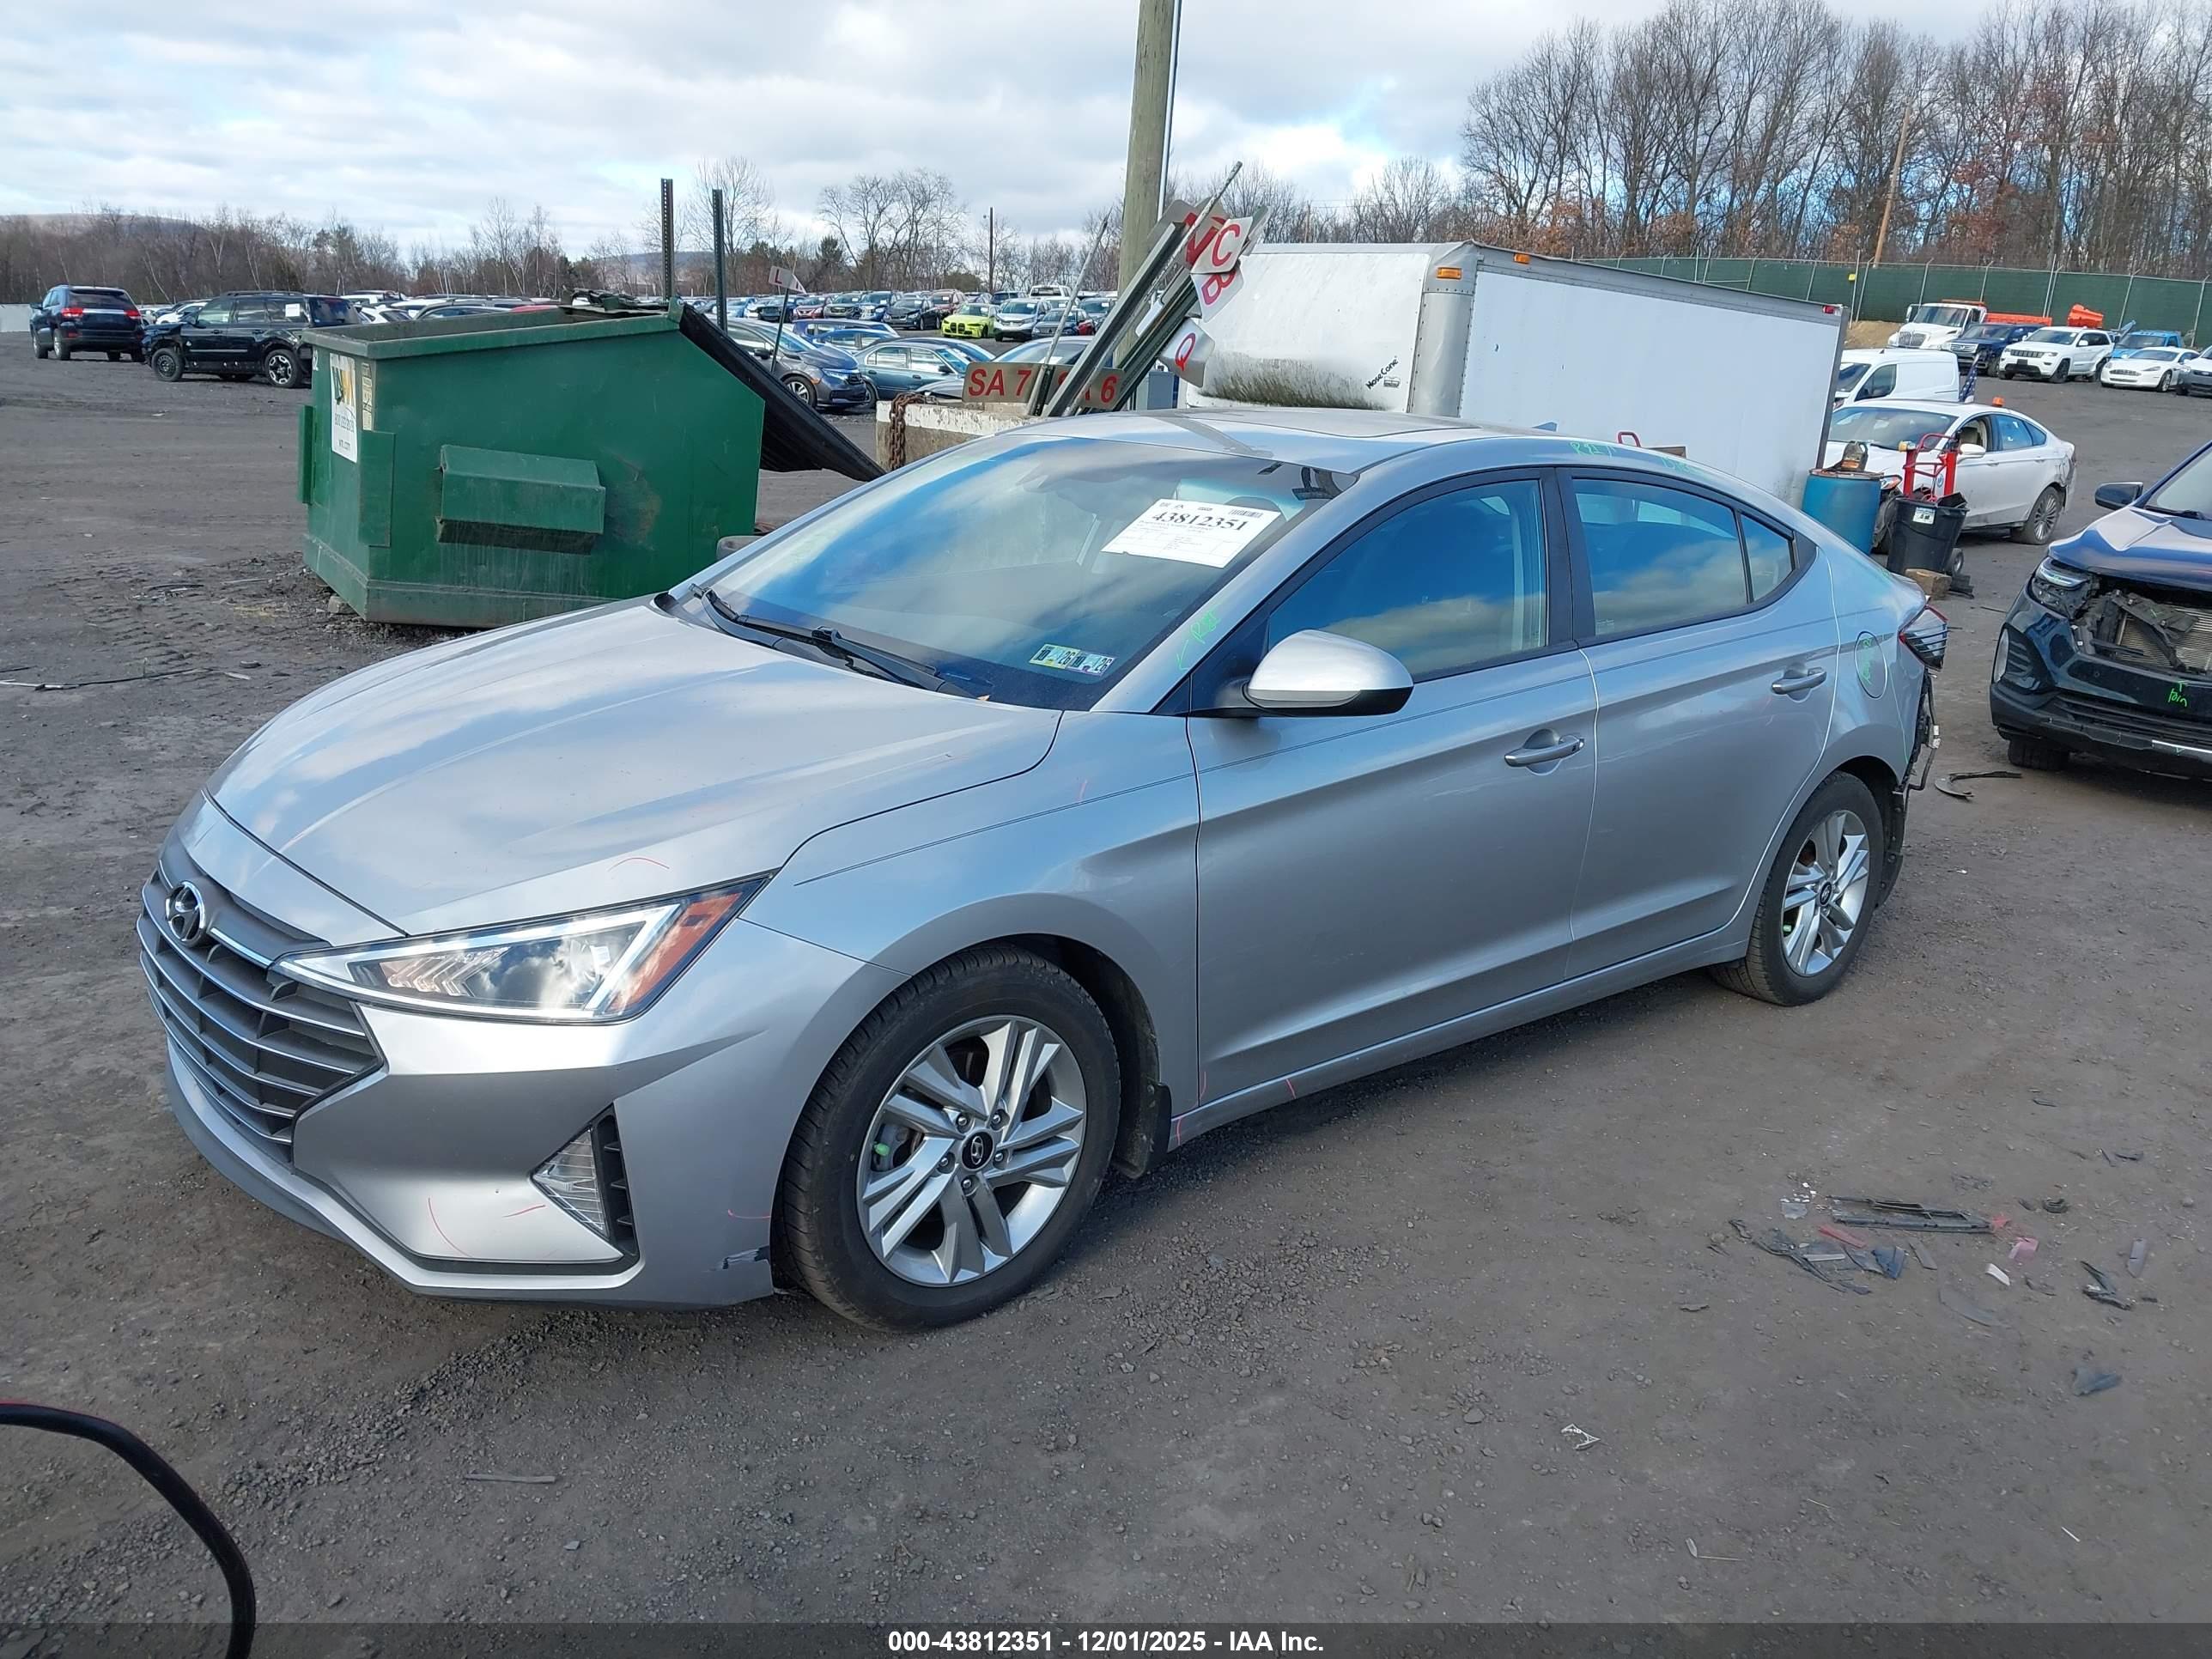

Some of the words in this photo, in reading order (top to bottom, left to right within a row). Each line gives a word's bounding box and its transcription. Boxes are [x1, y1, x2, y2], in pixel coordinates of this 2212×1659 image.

[1212, 223, 1241, 267] C
[1175, 332, 1196, 371] Q
[968, 368, 1005, 397] SA
[1016, 369, 1031, 397] 7
[1100, 375, 1118, 404] 6
[1152, 511, 1249, 531] 43812351
